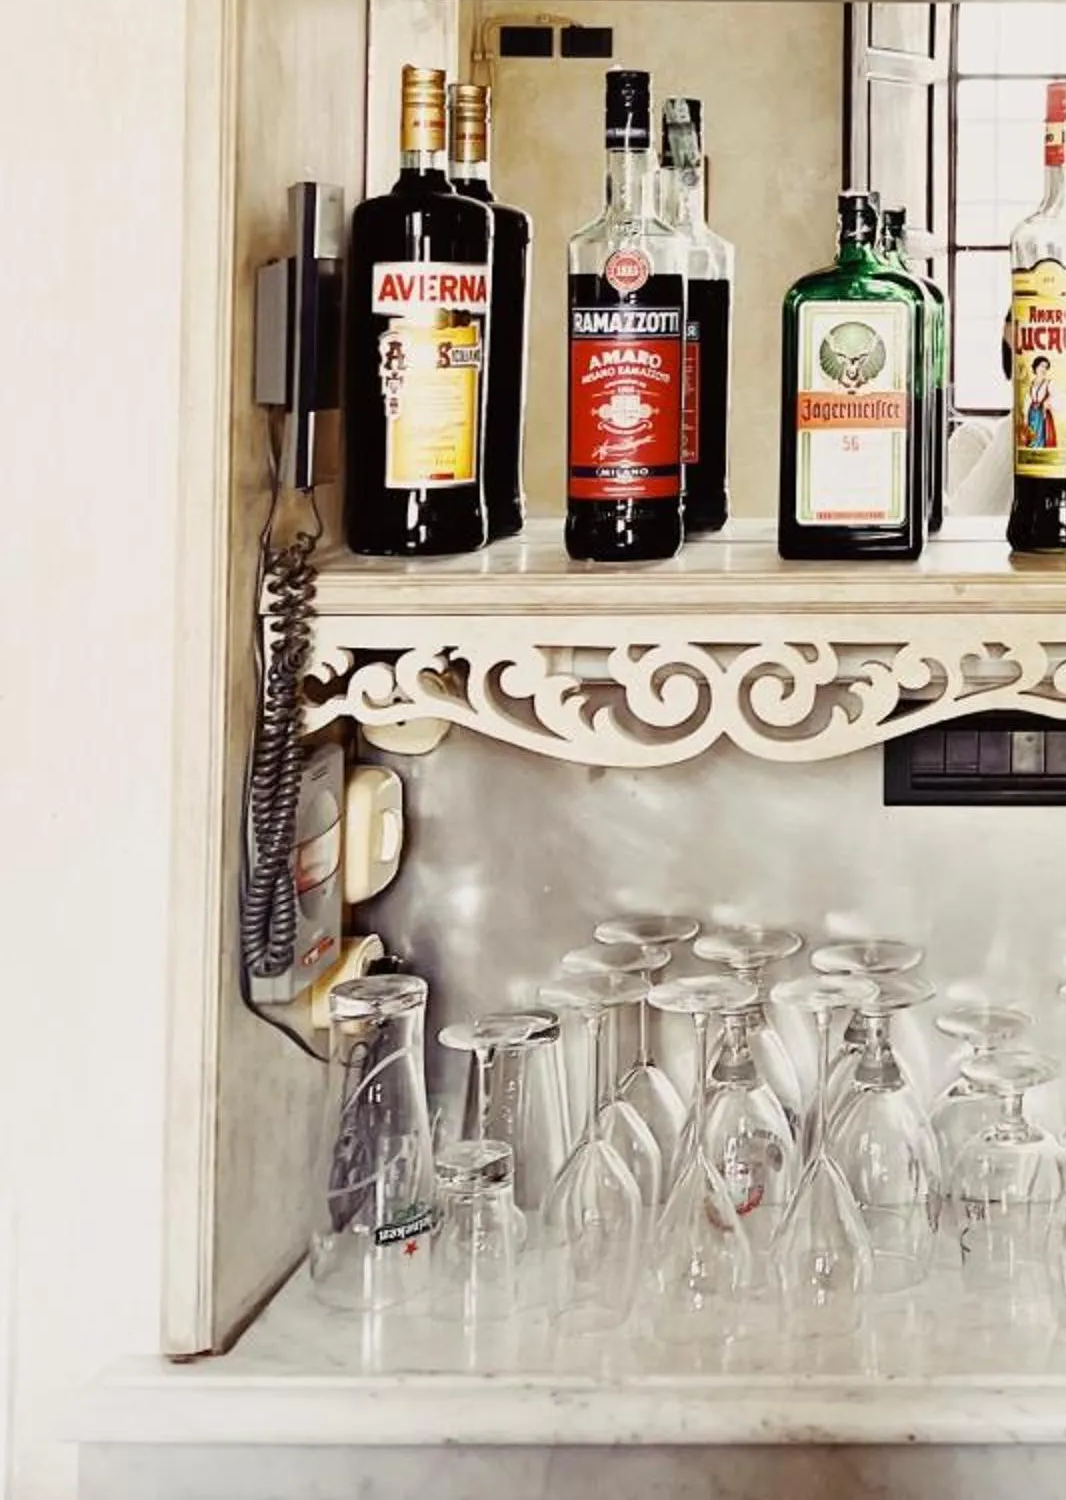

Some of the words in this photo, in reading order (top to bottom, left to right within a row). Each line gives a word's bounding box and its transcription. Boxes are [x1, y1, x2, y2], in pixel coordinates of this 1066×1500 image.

[378, 273, 488, 302] AVERNA
[574, 311, 679, 333] RAMAZZOTTI
[589, 348, 662, 371] AMARO
